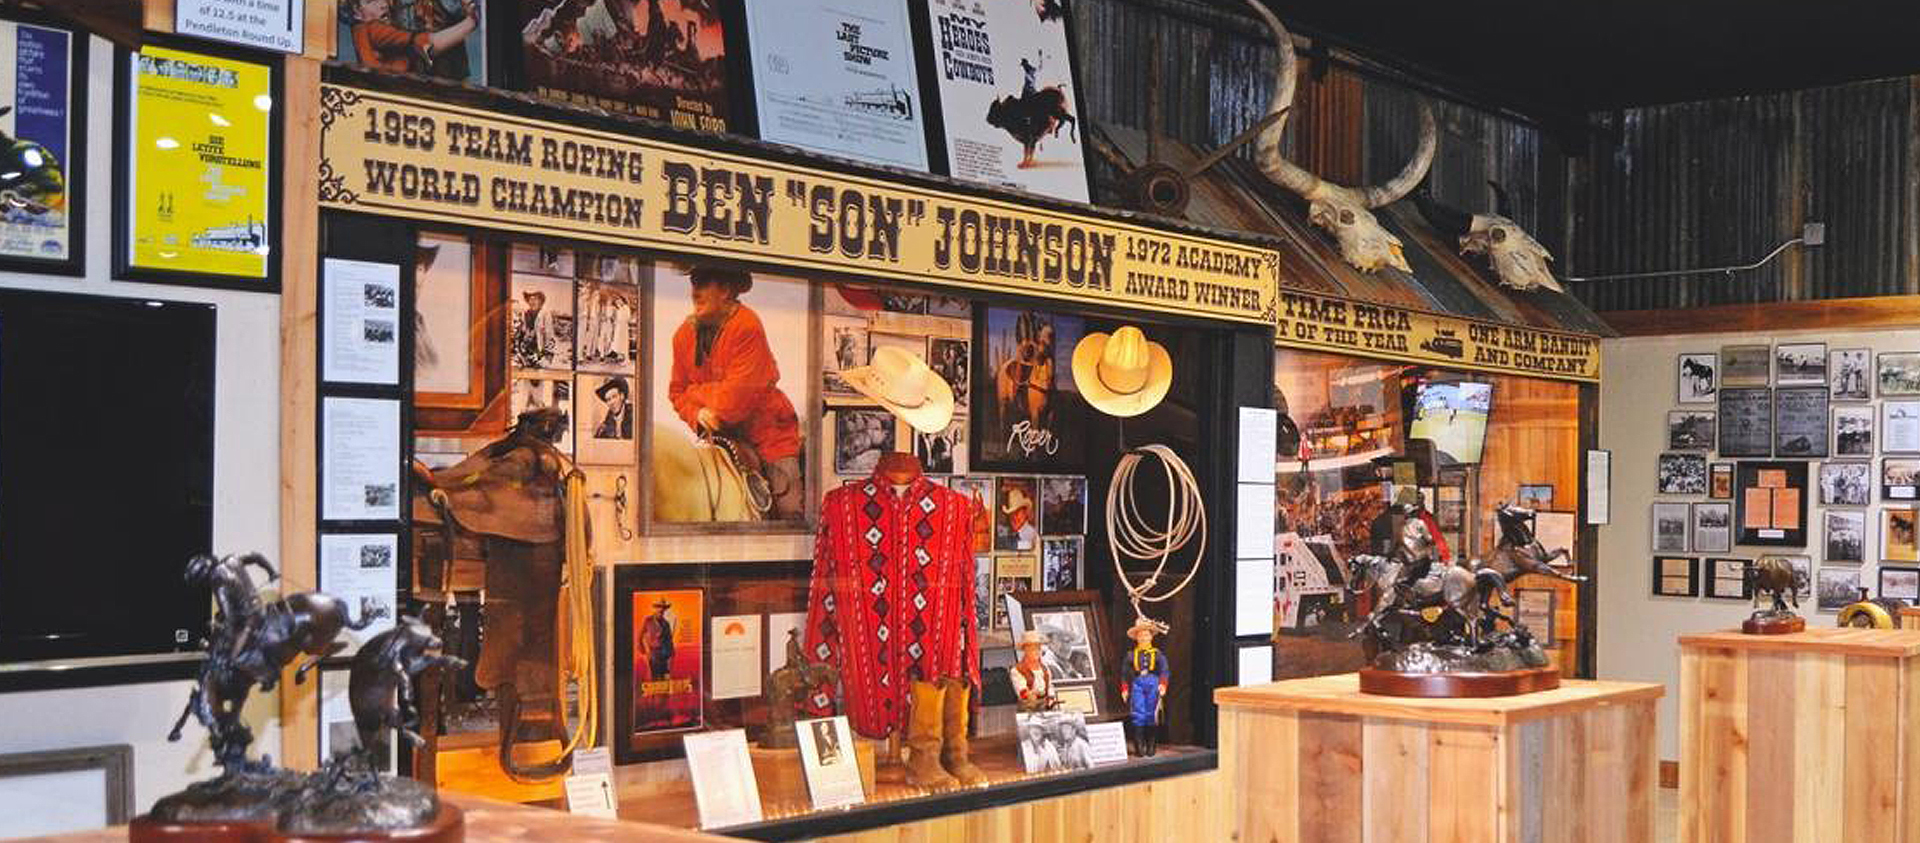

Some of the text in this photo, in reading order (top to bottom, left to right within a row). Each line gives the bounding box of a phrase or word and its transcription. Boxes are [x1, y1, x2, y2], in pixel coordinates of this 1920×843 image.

[200, 7, 210, 15] of
[213, 8, 235, 20] 12.5
[249, 15, 266, 26] the
[257, 1, 280, 11] time
[950, 13, 986, 29] MY
[186, 19, 239, 38] Pendleton
[242, 30, 275, 44] Round
[836, 30, 860, 43] LAST
[842, 22, 861, 35] THE
[938, 15, 990, 55] HEROES
[844, 51, 871, 65] SHOW
[850, 44, 890, 61] PICTURE
[943, 51, 995, 85] COWBOYS
[364, 107, 644, 183] 1953 TEAM ROPING
[364, 158, 644, 228] WORLD CHAMPION
[661, 160, 1117, 292] BEN "SON" JOHNSON
[1125, 236, 1262, 280] 1972 ACADEMY
[1125, 271, 1262, 311] AWARD WINNER
[1281, 293, 1412, 331] TIME PRCA
[1295, 322, 1318, 340] OF
[1323, 327, 1358, 346] THE
[1362, 332, 1409, 352] YEAR
[1468, 323, 1591, 356] ONE ARM BANDIT
[1474, 345, 1588, 374] AND COMPANY
